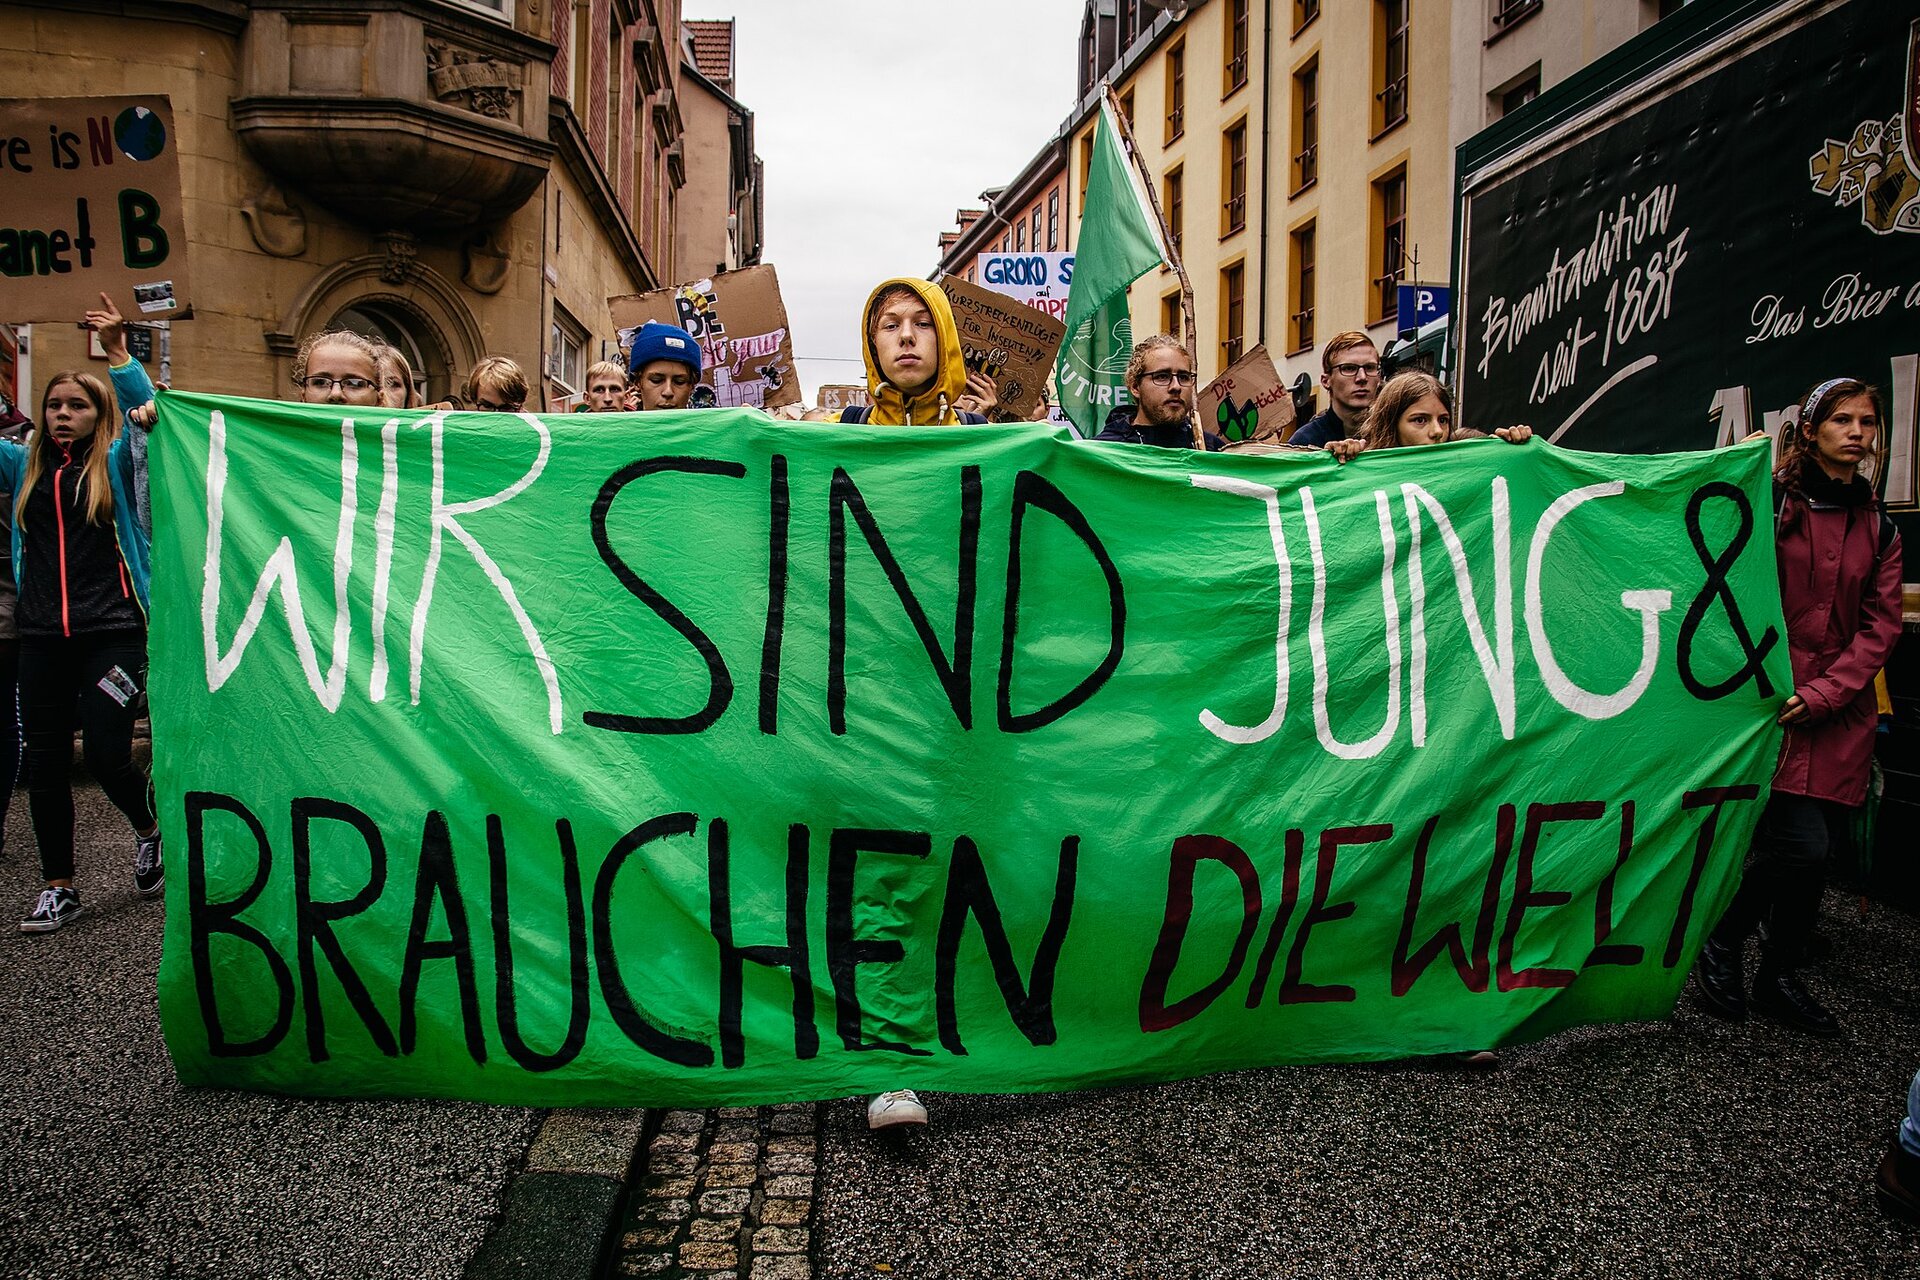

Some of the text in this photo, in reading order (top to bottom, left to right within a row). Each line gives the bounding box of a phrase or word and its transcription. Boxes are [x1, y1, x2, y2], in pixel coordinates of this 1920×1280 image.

[50, 125, 81, 169] is
[118, 188, 170, 269] B
[985, 256, 1047, 286] GROKO
[1036, 285, 1051, 298] auf
[1477, 184, 1677, 379] Brautradition
[1417, 290, 1434, 311] P
[1529, 227, 1690, 404] seit 1887
[1745, 294, 1806, 344] Das
[1813, 272, 1900, 329] Bier
[732, 330, 785, 376] your
[1060, 357, 1129, 406] UTURE
[1210, 378, 1237, 402] Die
[201, 410, 1779, 760] WIR SIND JUNG &
[184, 784, 1761, 1073] BRAUCHEN DIE WELT
